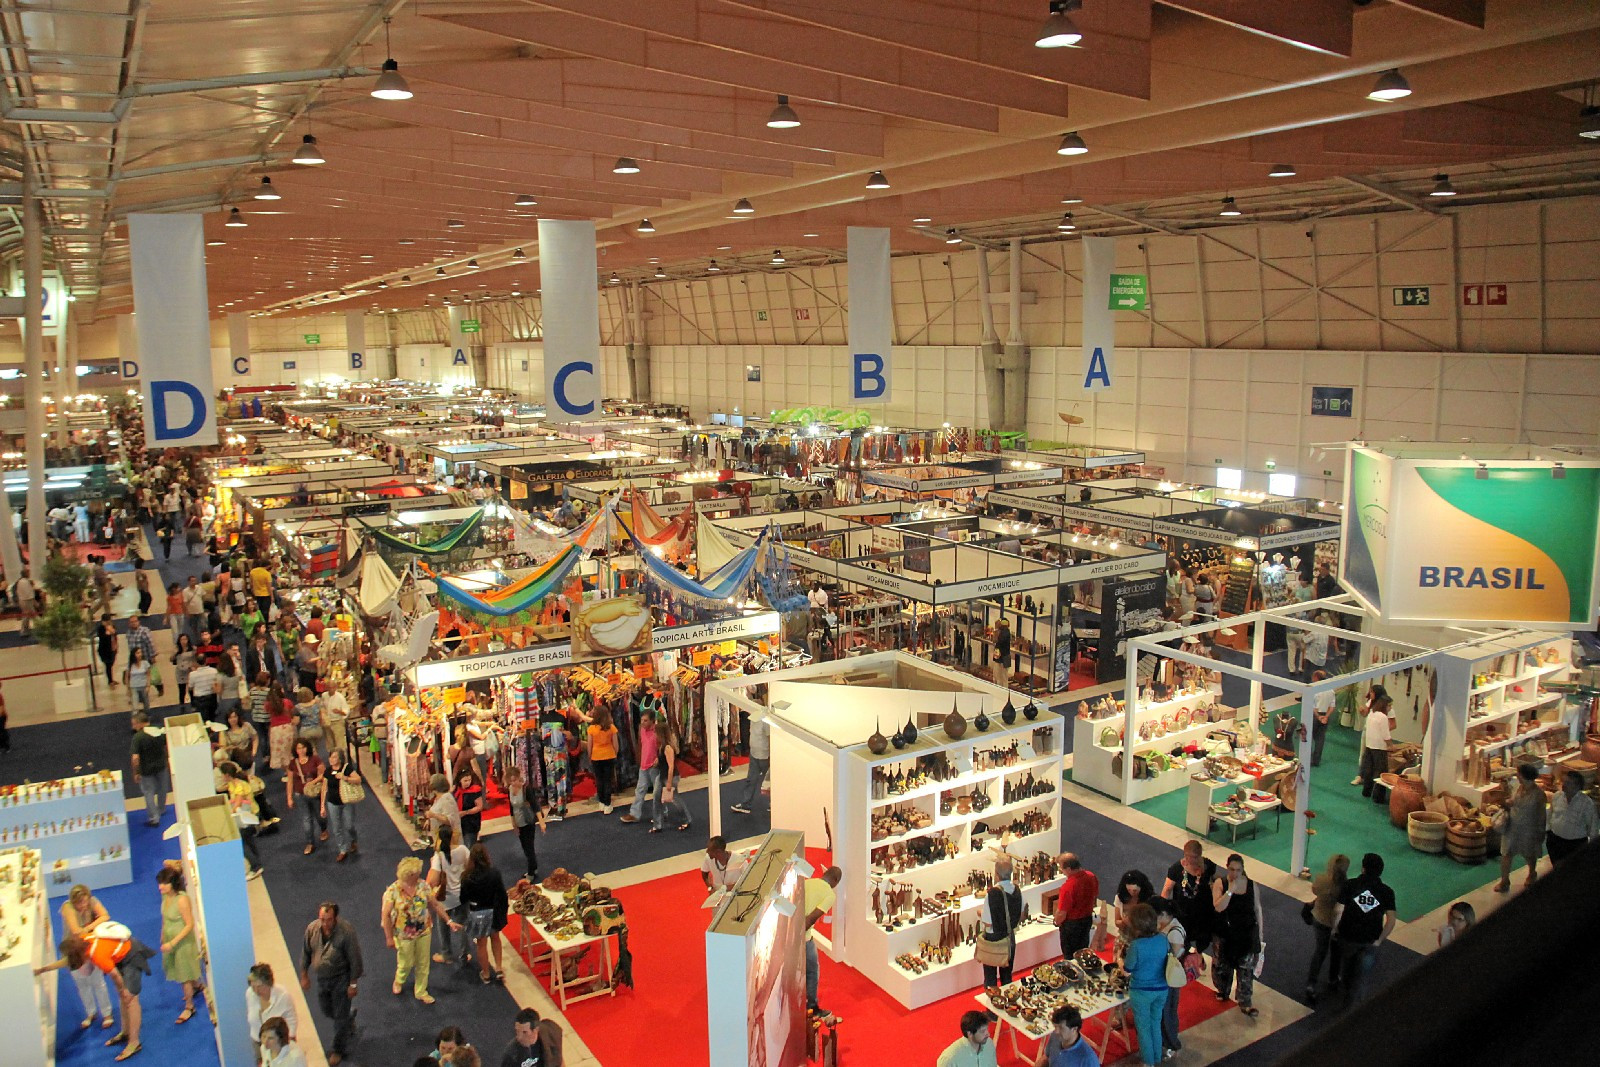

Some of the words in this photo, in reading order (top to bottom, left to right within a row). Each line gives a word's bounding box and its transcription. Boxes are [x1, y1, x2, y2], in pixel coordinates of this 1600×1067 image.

[1112, 286, 1144, 295] EMERGÊNCIA
[351, 352, 363, 369] B
[453, 348, 468, 365] A
[122, 361, 139, 378] D
[233, 357, 249, 375] C
[1083, 347, 1111, 388] A
[853, 354, 887, 399] B
[553, 361, 595, 416] C
[151, 381, 207, 441] D
[528, 473, 565, 482] GALERIA
[575, 470, 613, 479] ELDORADO
[1154, 523, 1171, 532] CAPIM
[1171, 526, 1198, 536] DOURADO
[1363, 513, 1387, 539] MERCOSUL
[1091, 563, 1113, 574] ATELIER
[1115, 563, 1123, 571] DO
[1125, 560, 1140, 570] CABO
[866, 573, 900, 590] MOÇAMBIQUE
[977, 579, 1021, 593] MOÇAMBIQUE
[1419, 566, 1545, 590] BRASIL
[652, 633, 690, 644] ROPICAL
[692, 628, 714, 639] ARTE
[716, 623, 746, 636] BRASIL
[459, 660, 508, 673] TROPICAL
[510, 655, 536, 667] ARTE
[538, 650, 572, 663] BRASIL
